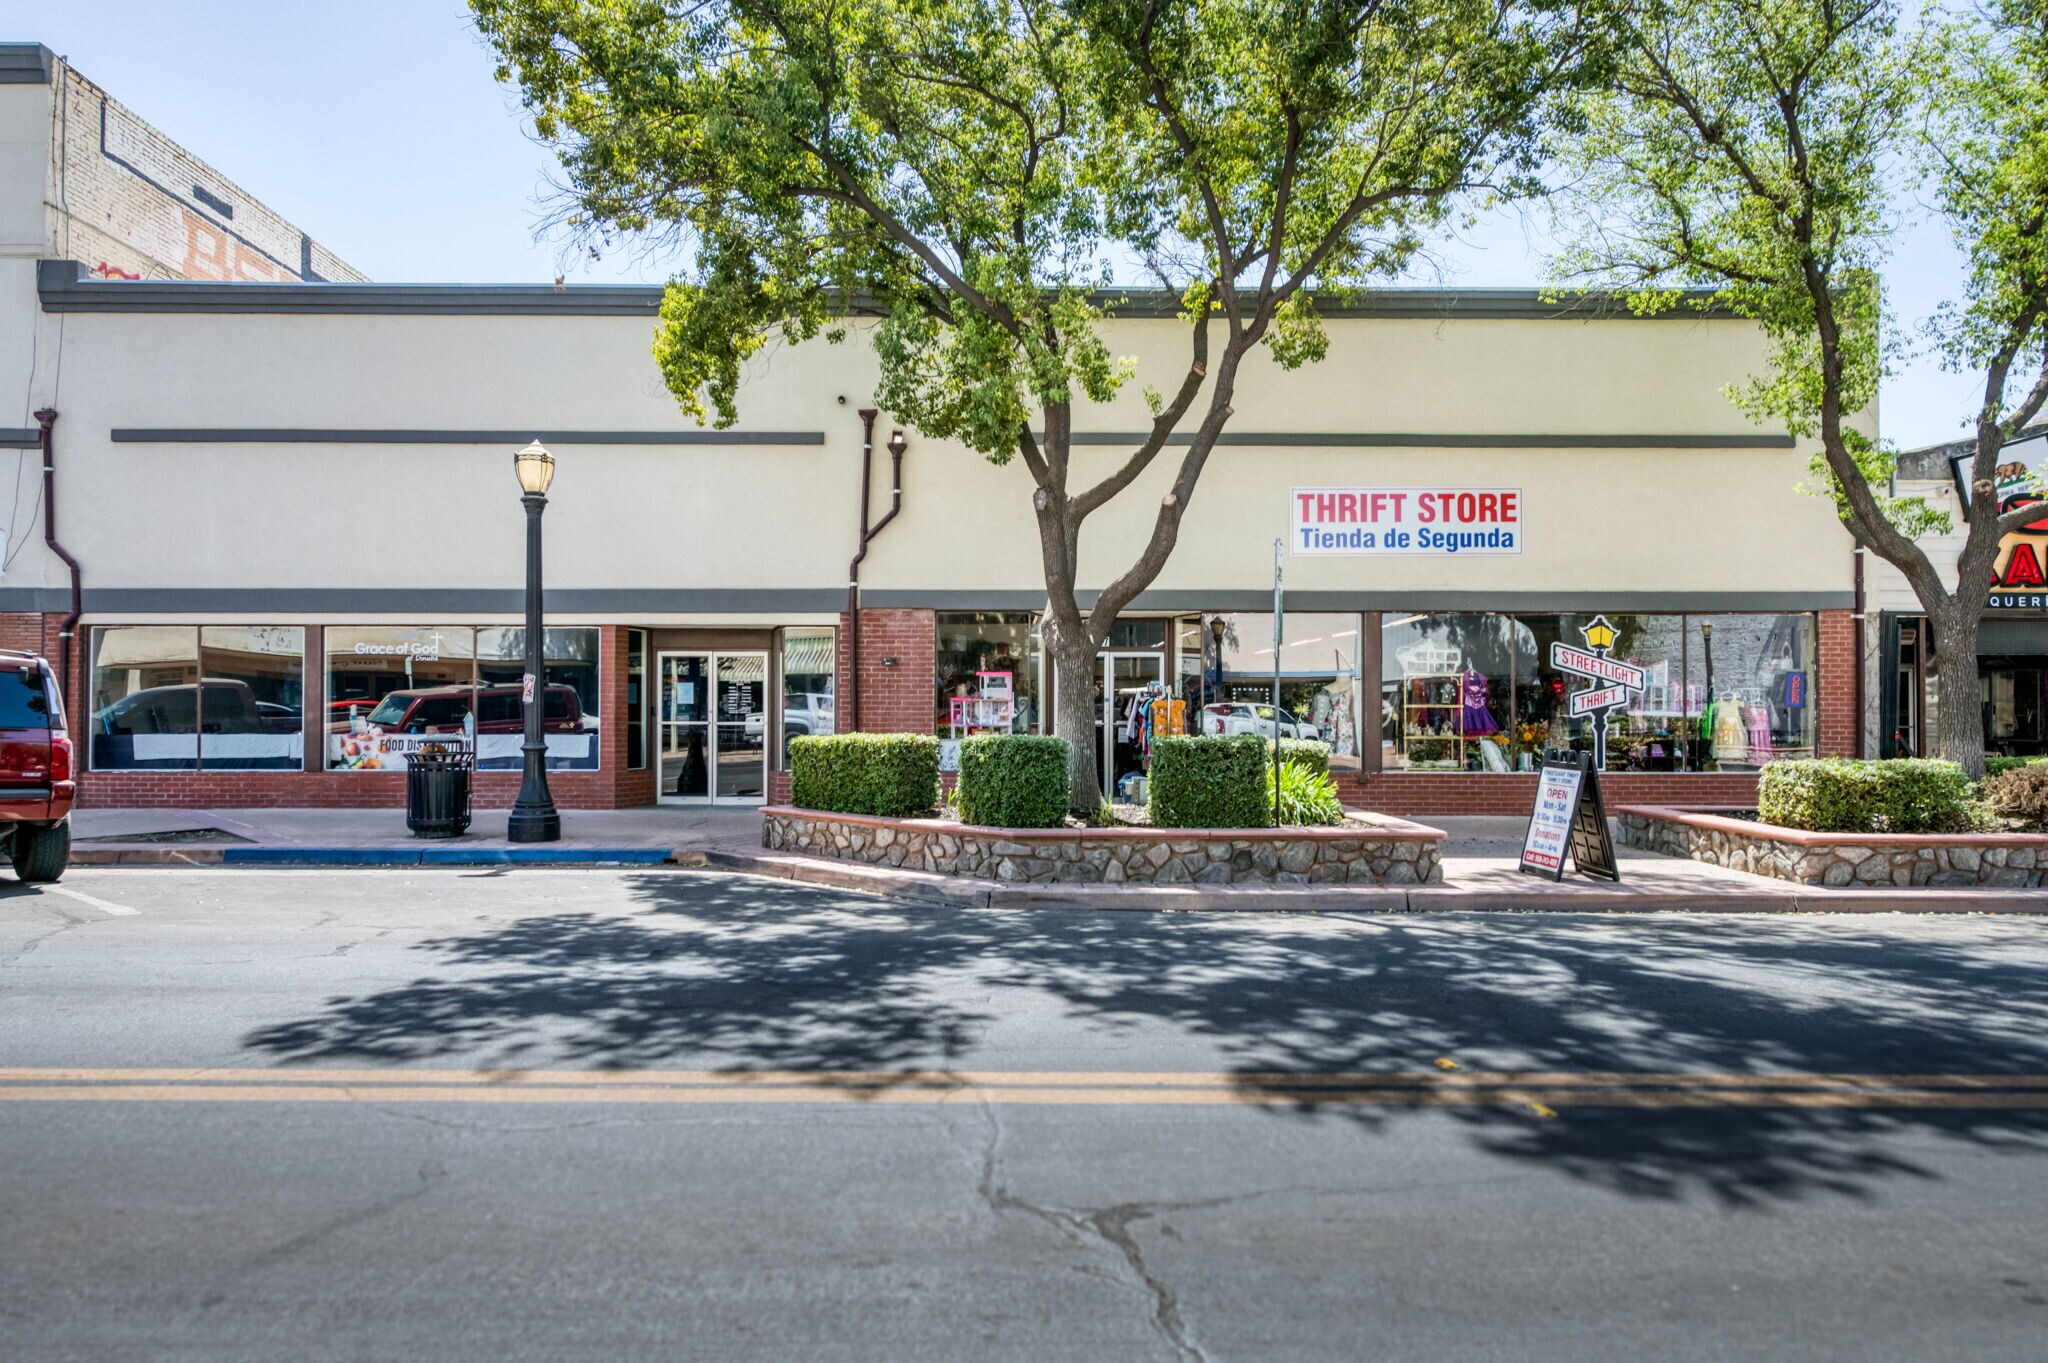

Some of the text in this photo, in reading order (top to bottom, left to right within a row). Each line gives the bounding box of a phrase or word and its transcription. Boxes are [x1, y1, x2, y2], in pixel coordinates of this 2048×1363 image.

[1297, 492, 1517, 523] THRIFT STORE
[1300, 528, 1513, 552] Tienda de Segunda
[355, 637, 440, 654] Grace of God
[1562, 650, 1636, 684] STREETLIGHT
[1580, 688, 1617, 709] THRIFT
[1791, 675, 1801, 704] OPEN
[380, 739, 404, 751] FOOD
[1546, 788, 1569, 800] OPEN
[1543, 800, 1554, 810] Mon
[1535, 827, 1561, 841] Donations
